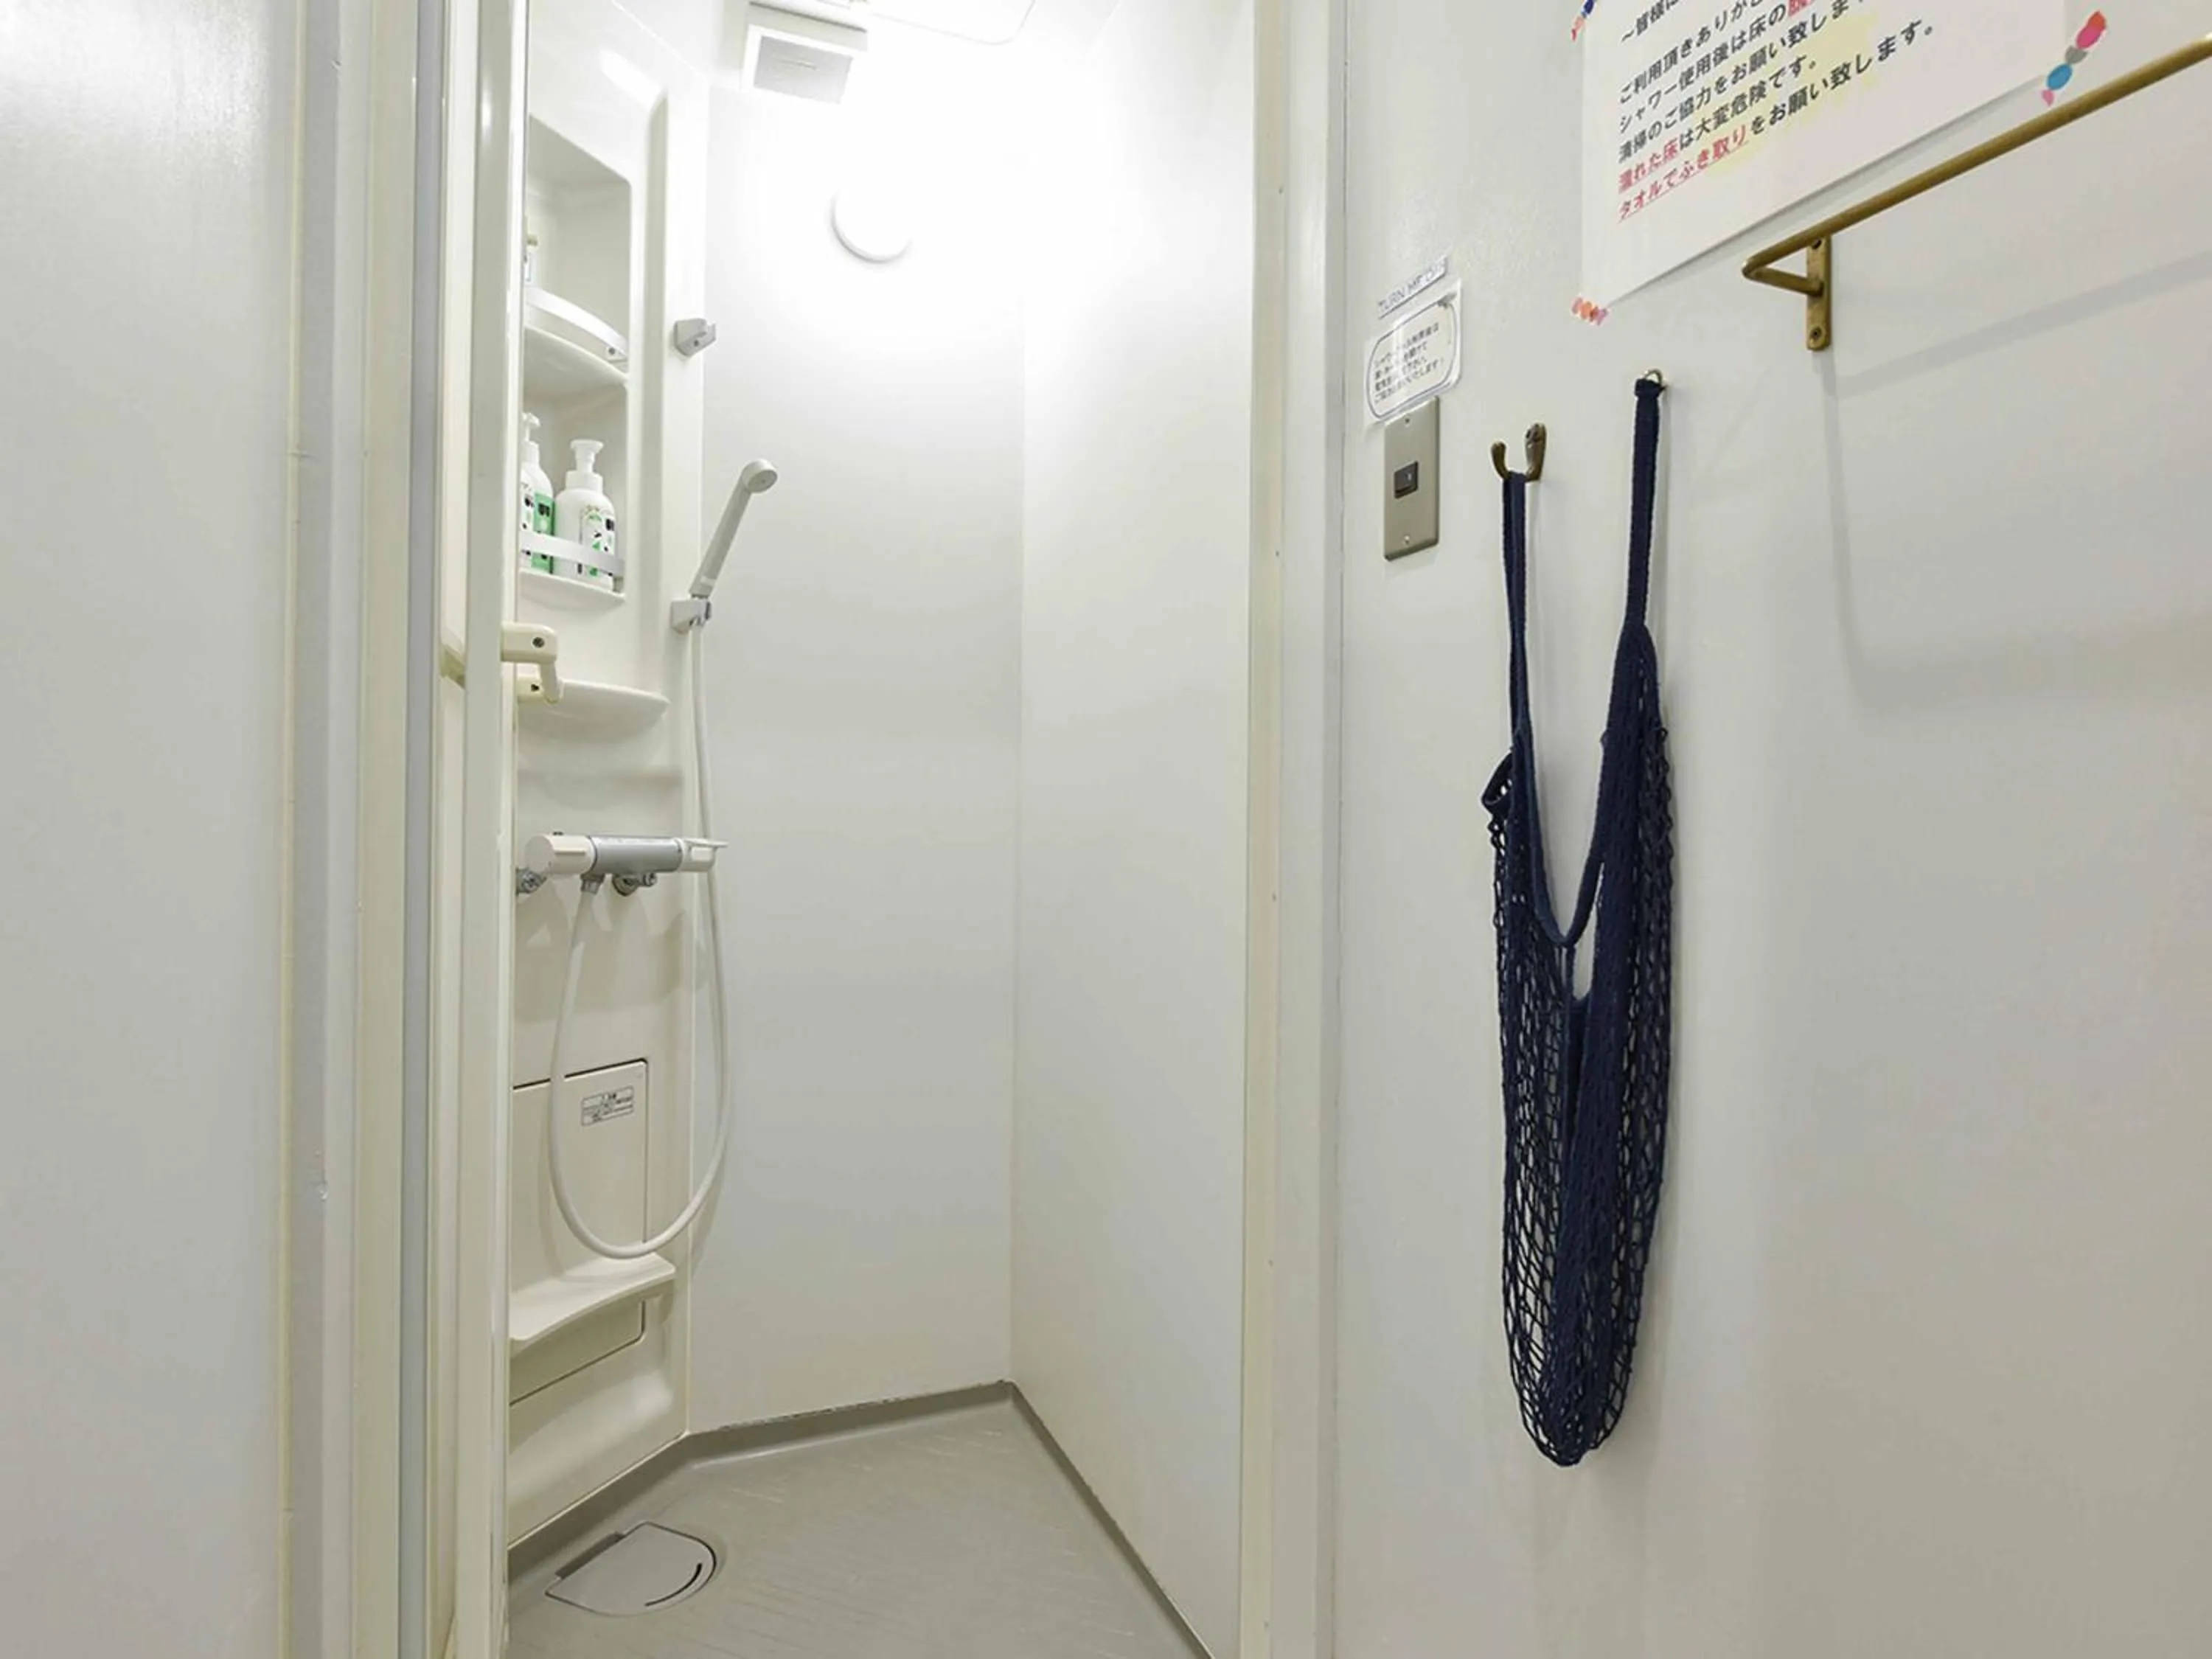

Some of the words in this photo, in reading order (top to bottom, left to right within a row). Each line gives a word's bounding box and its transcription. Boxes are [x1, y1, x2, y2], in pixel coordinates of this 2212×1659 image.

[1618, 0, 1863, 163] 清掃のご協力をお願い致しま
[1618, 19, 1933, 221] タオルでふき取りをお願い致します。
[1618, 55, 1816, 193] 濡れた床は大変危険です。
